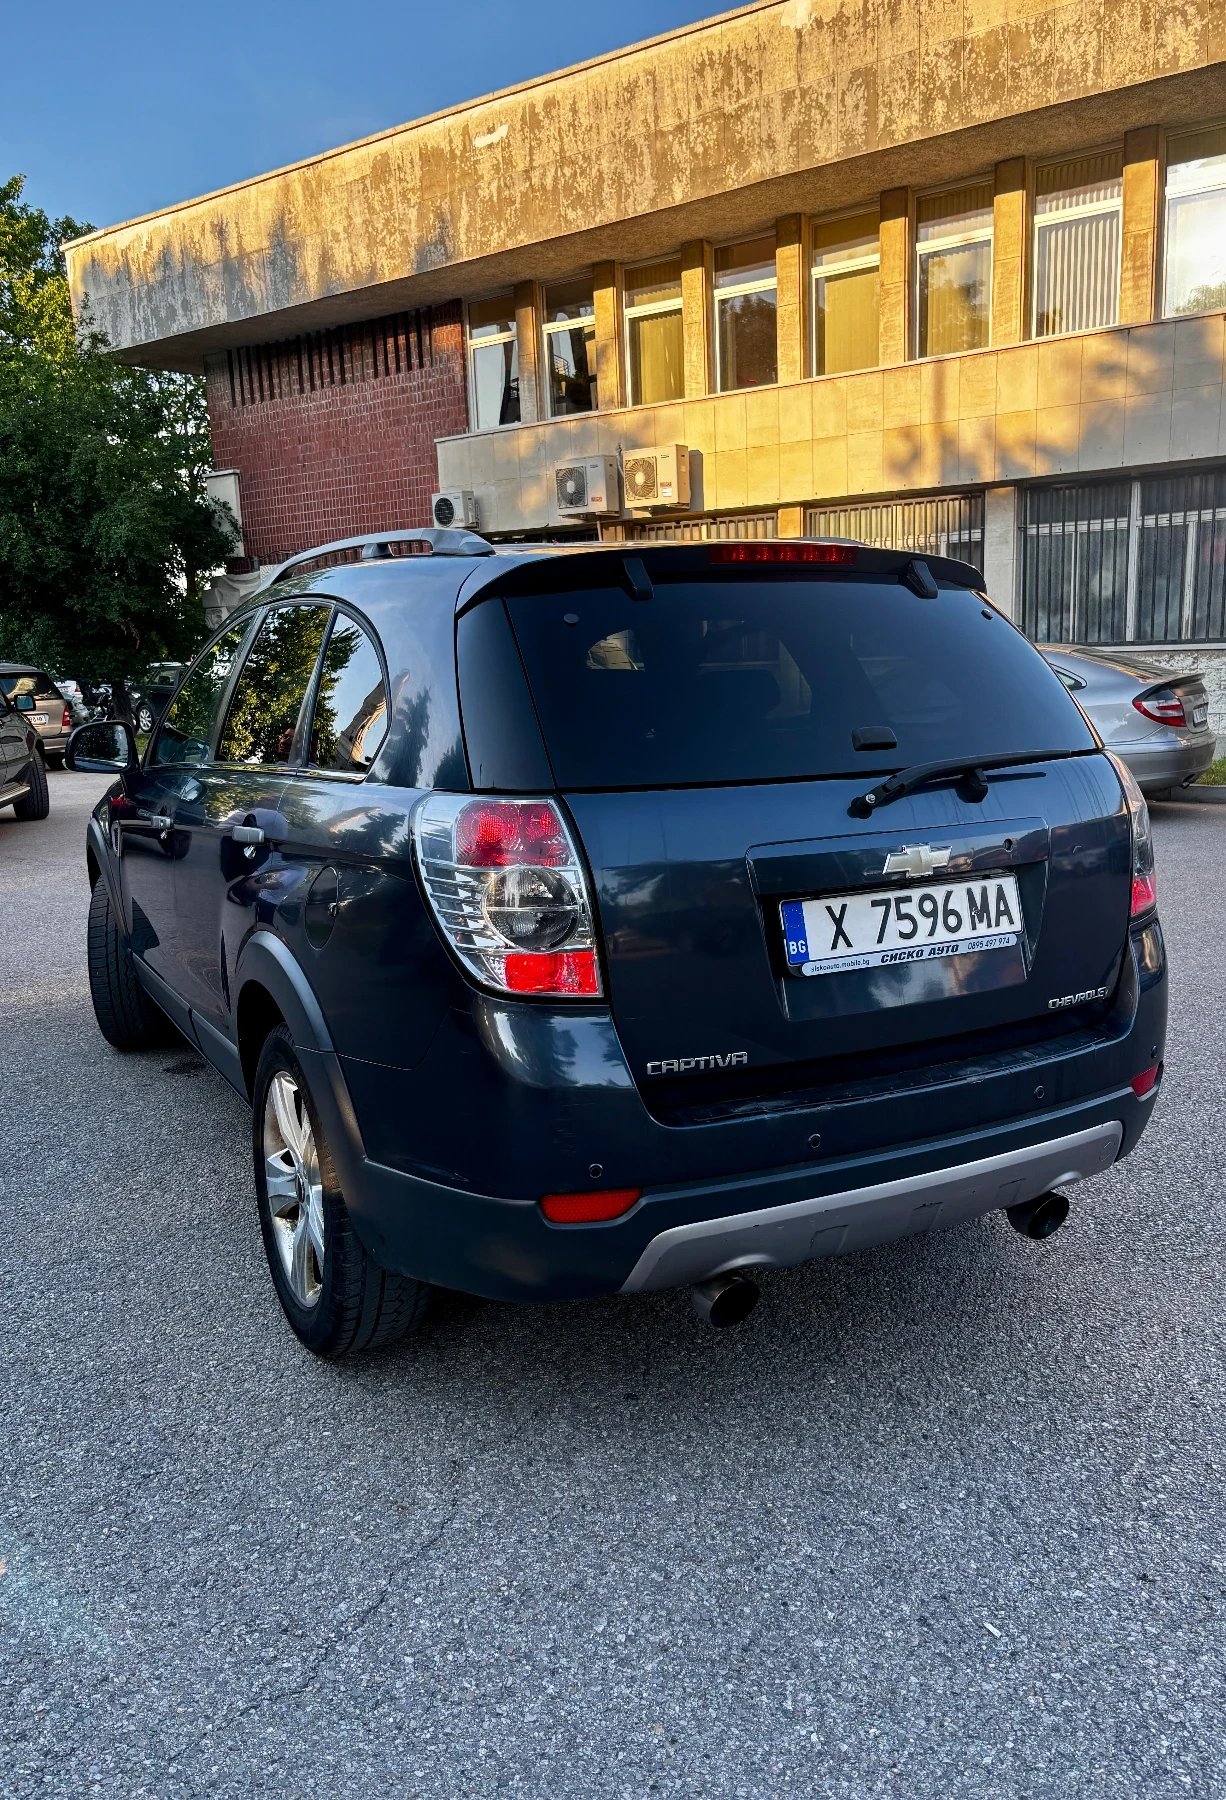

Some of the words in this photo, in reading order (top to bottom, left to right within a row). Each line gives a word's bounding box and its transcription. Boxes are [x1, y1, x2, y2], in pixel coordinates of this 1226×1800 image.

[825, 904, 853, 950] X
[870, 890, 963, 944] 7596
[790, 940, 807, 955] BG
[967, 940, 984, 950] 0895
[985, 938, 997, 948] 497
[998, 937, 1010, 946] 974
[881, 949, 924, 963] СИСКО
[928, 944, 960, 957] АУТО
[647, 1051, 748, 1074] CAPTIVA
